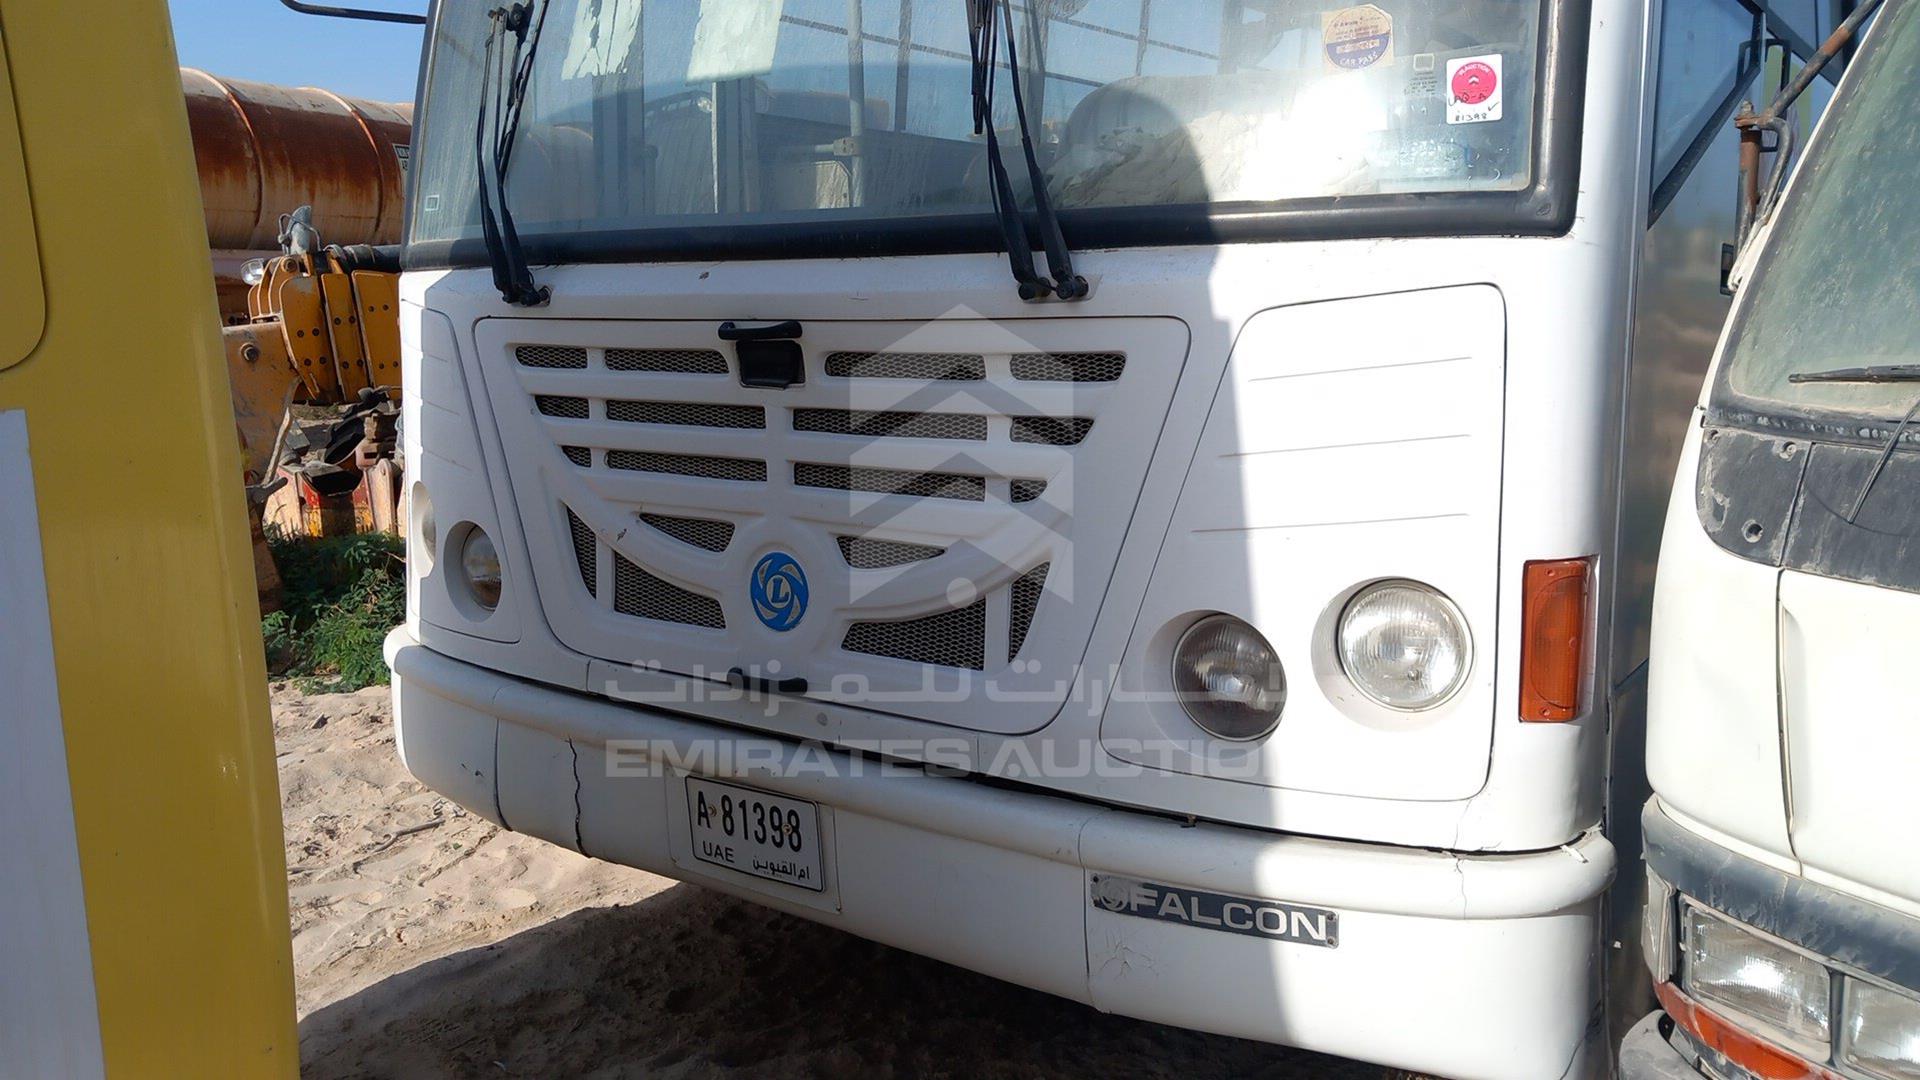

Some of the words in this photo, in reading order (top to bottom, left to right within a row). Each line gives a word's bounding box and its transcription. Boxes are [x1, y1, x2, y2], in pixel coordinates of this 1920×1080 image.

[697, 791, 711, 829] A
[720, 794, 802, 853] 81398
[702, 840, 735, 864] UAE
[1130, 886, 1326, 941] FALCON
